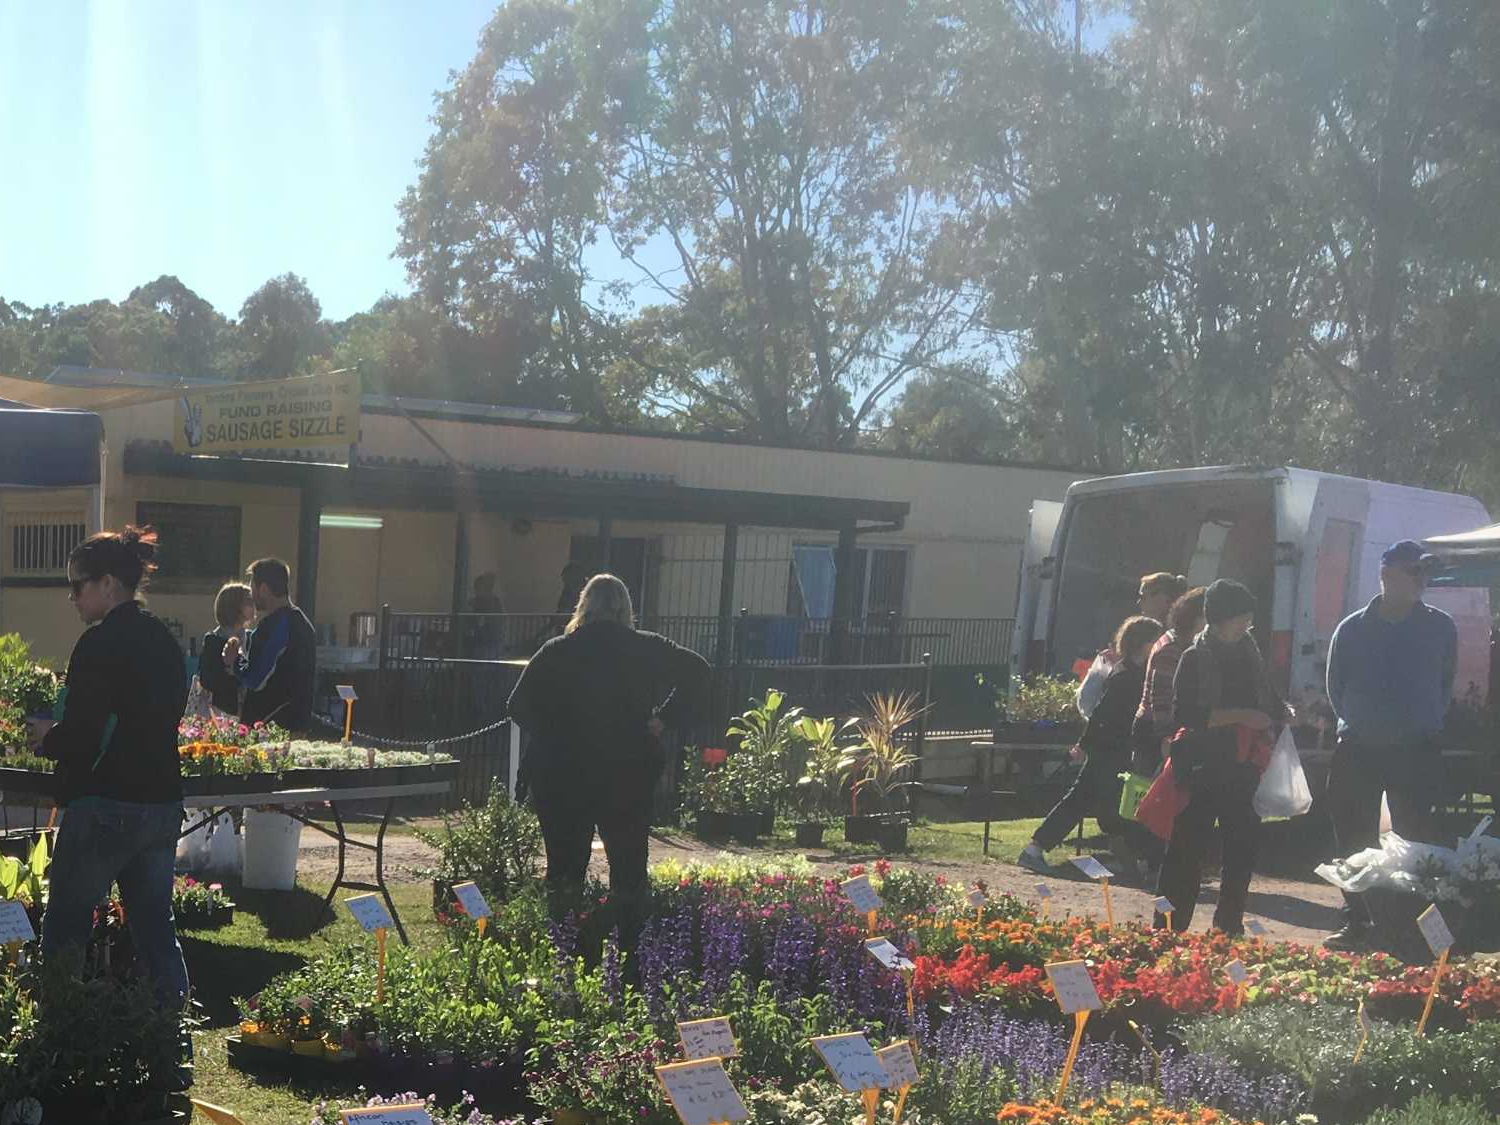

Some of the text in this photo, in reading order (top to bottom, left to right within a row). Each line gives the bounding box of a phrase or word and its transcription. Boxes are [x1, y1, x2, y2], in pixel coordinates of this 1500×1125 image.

[219, 400, 333, 419] FUND RAISING
[206, 415, 346, 443] SAUSAGE SIZZLE
